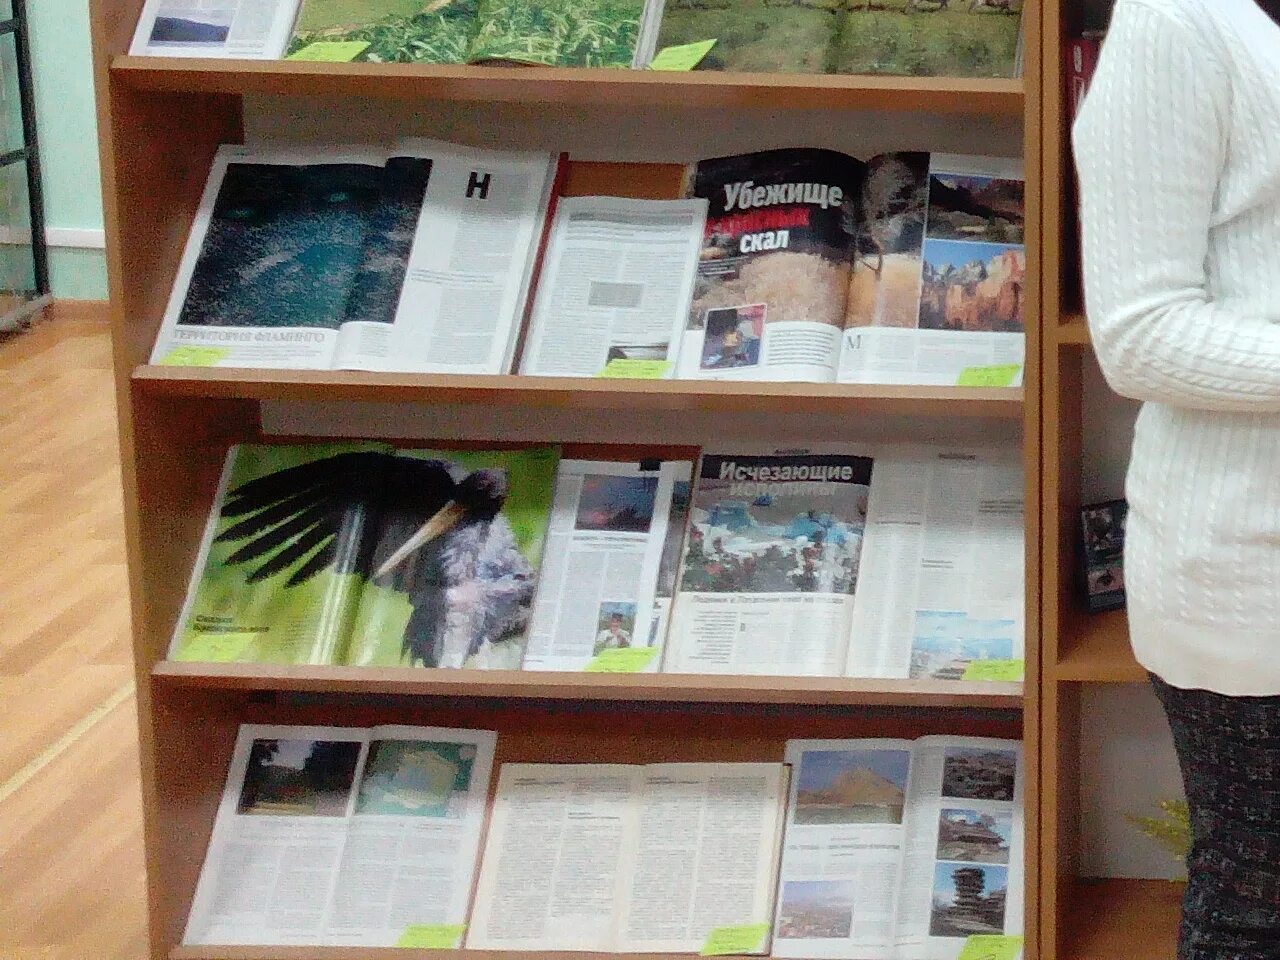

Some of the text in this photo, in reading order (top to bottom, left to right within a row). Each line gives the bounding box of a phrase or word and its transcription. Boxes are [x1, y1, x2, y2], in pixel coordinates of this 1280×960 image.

[724, 180, 843, 211] Убежище
[740, 230, 790, 253] скал
[719, 461, 853, 482] Исчезающие
